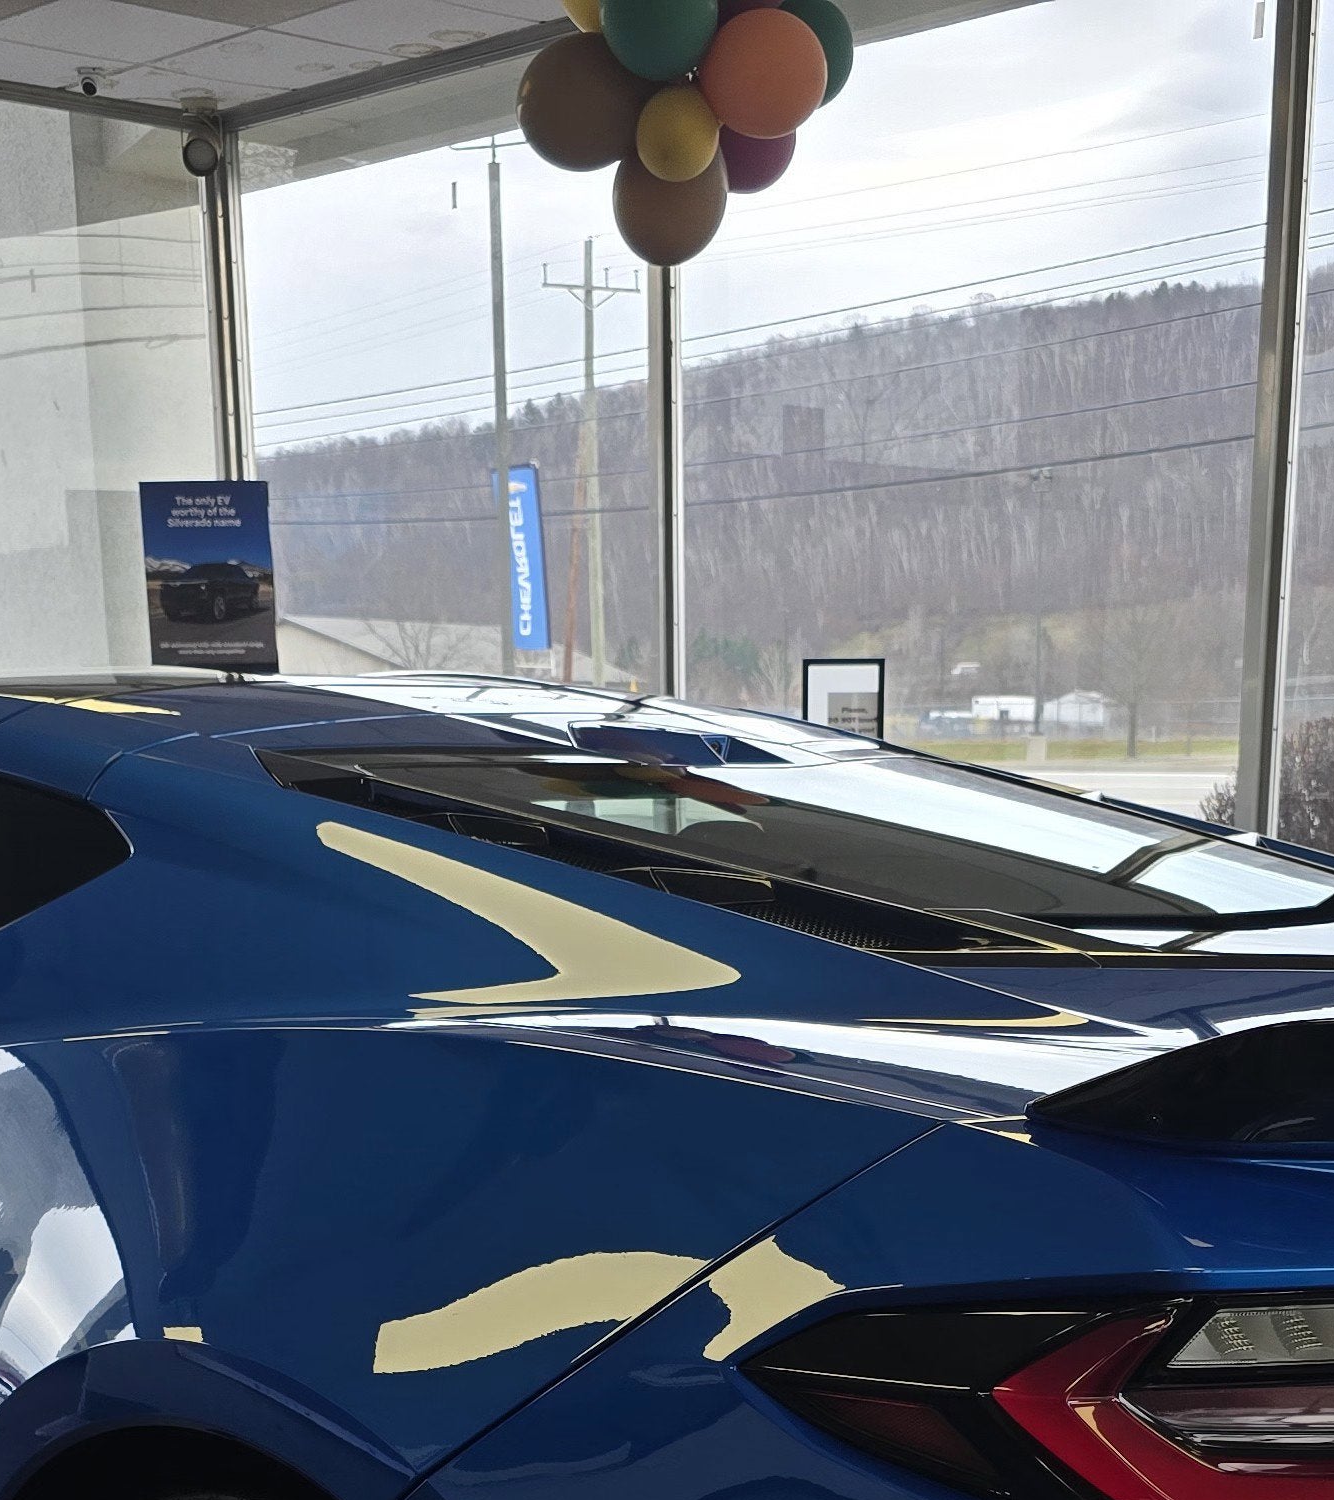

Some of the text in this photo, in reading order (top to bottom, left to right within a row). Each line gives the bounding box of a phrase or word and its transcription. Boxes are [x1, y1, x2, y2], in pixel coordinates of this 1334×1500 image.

[175, 495, 232, 507] The only EV
[170, 507, 236, 518] worthy of the
[167, 518, 242, 528] Silverado name
